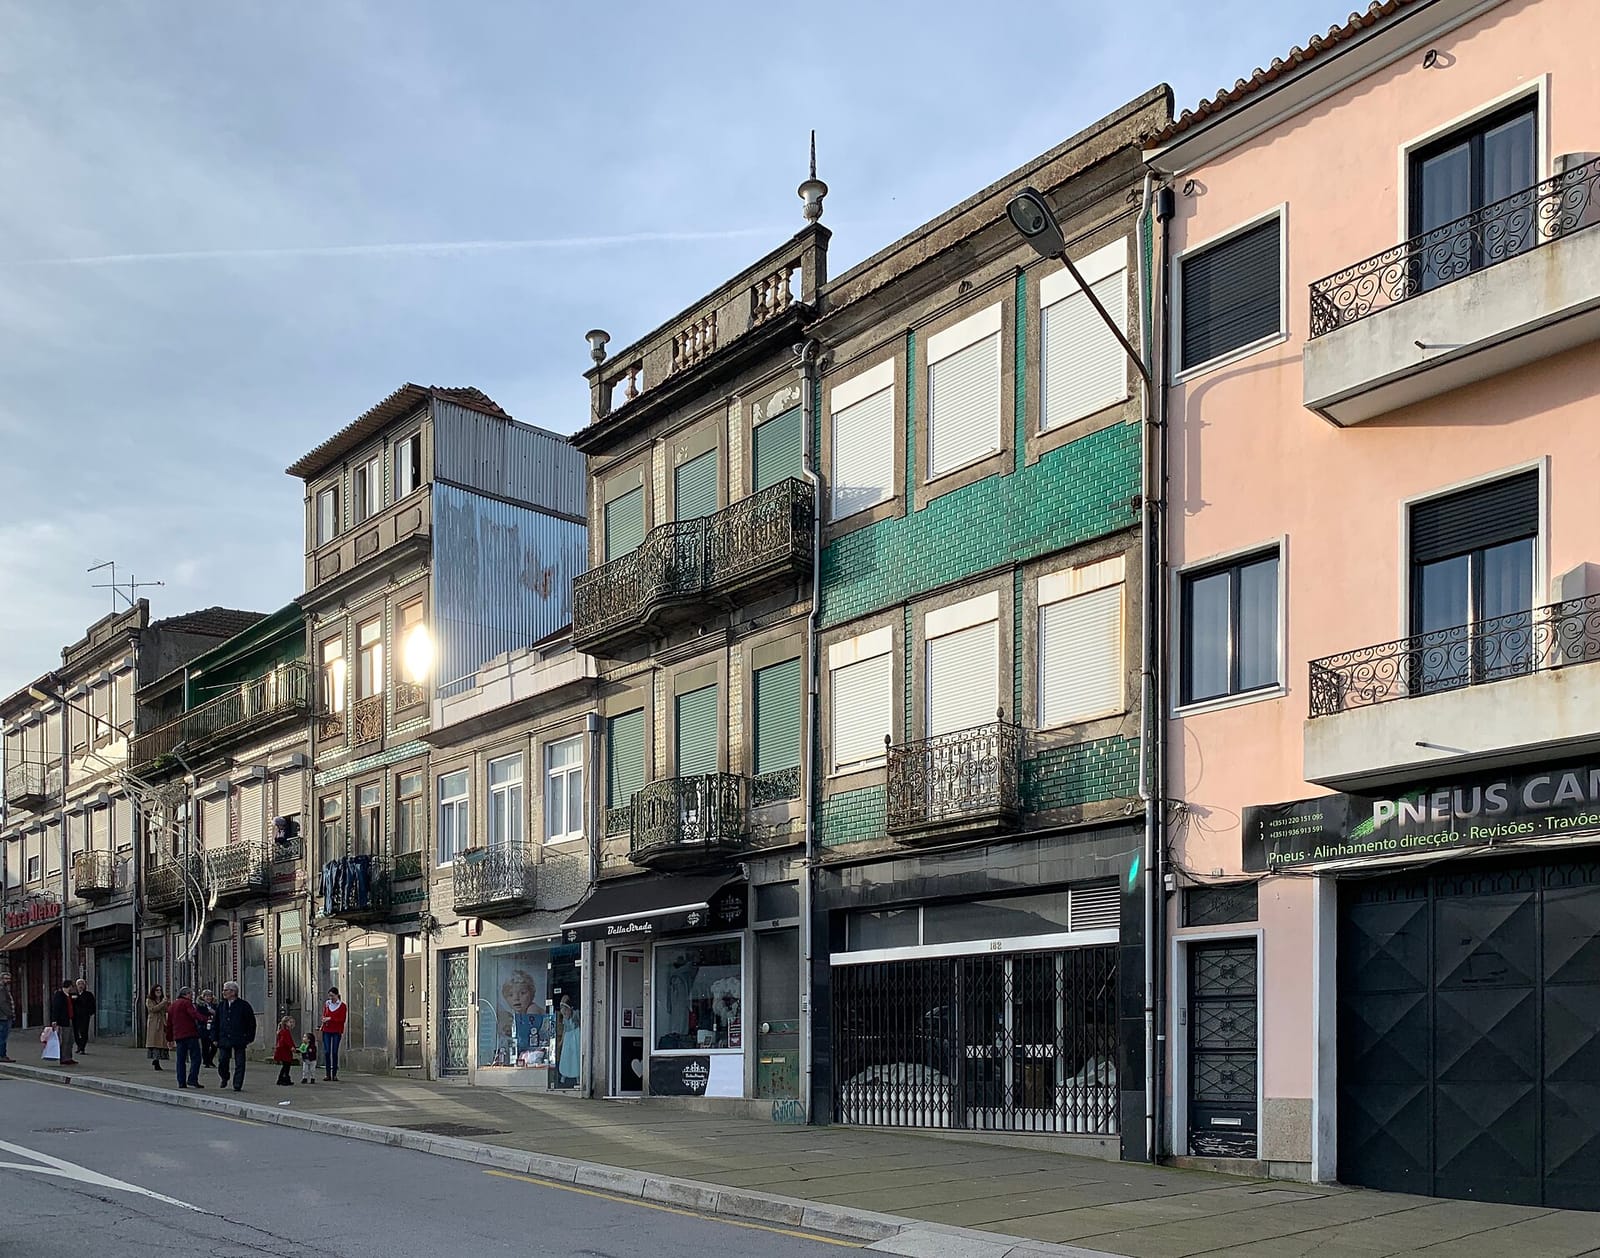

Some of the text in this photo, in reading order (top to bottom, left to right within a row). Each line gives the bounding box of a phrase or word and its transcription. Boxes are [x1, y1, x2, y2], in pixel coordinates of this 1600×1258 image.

[1288, 817, 1300, 825] 220
[1300, 815, 1311, 823] 151
[1373, 783, 1508, 829] PNEUS
[1269, 812, 1600, 864] Pneus Alinhamento direcção Revisões Travõe
[1288, 828, 1300, 837] 936
[1300, 826, 1311, 835] 913
